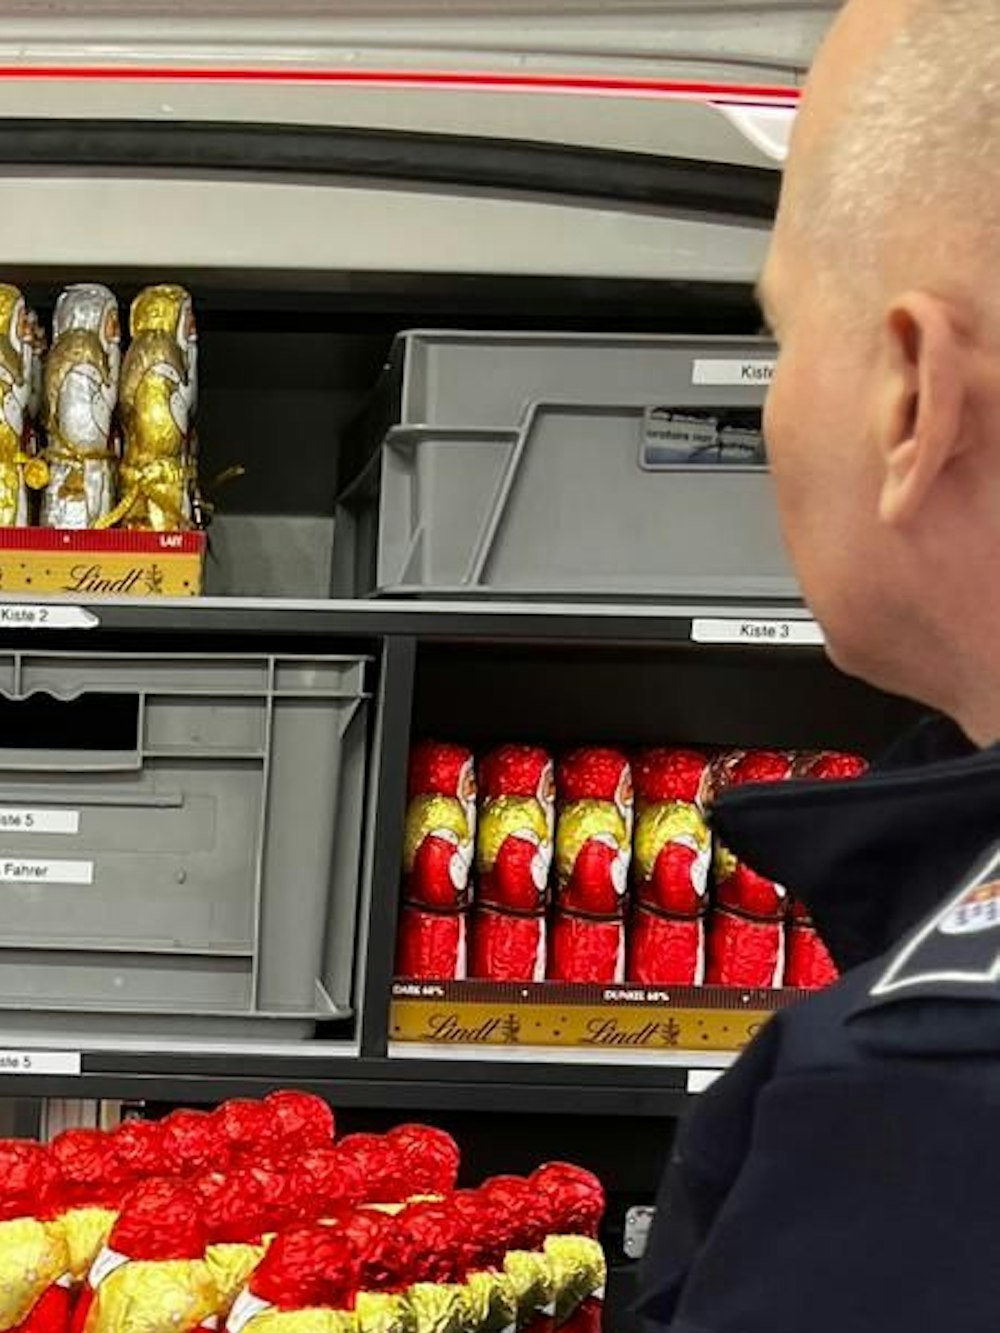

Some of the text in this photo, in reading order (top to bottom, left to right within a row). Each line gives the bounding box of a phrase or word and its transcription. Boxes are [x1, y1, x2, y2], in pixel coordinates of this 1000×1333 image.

[160, 534, 183, 547] LAIT
[61, 564, 144, 593] Lindt
[1, 608, 49, 621] Kiste 2
[739, 624, 790, 638] Kiste 3
[25, 814, 34, 827] 5
[4, 863, 48, 877] Fahrer
[423, 1014, 660, 1045] Lindt Lindt
[23, 1056, 31, 1069] 5
